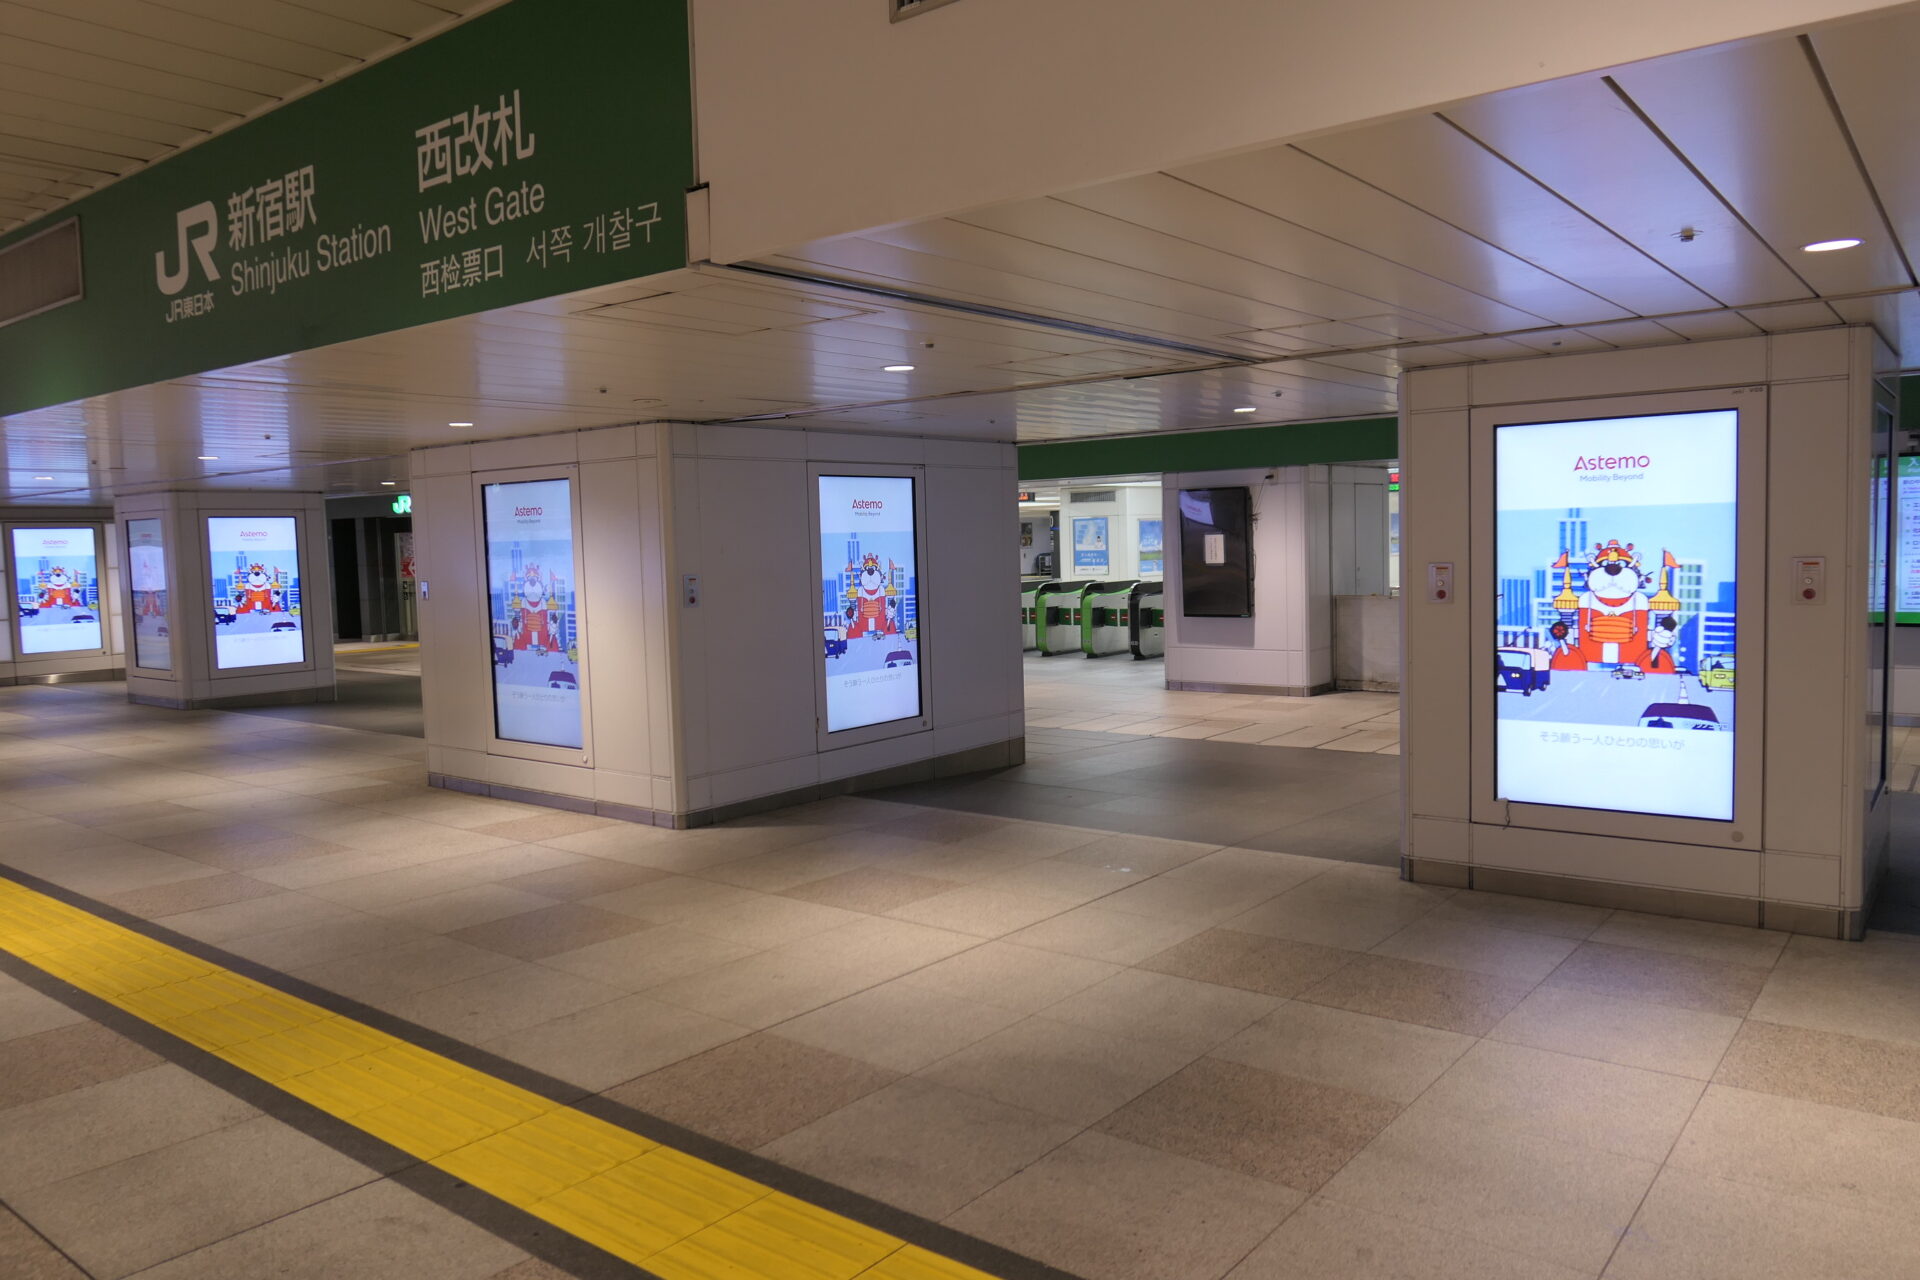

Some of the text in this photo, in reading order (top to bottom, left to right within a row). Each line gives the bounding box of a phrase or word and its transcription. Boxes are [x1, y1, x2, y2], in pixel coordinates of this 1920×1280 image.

[415, 89, 535, 193] 西改札
[228, 164, 317, 251] 新宿駅
[419, 181, 545, 244] West Gate
[526, 201, 662, 268] 서쪽 개찰구
[155, 200, 221, 295] JR
[231, 224, 391, 296] Shinjuku Station
[420, 244, 504, 298] 西检票口
[166, 291, 215, 323] JR東日本
[1574, 455, 1650, 471] Astemo
[1580, 473, 1644, 482] Mobility Beyond
[392, 495, 412, 513] JR
[515, 506, 543, 516] Astemo
[852, 499, 883, 509] Astemo
